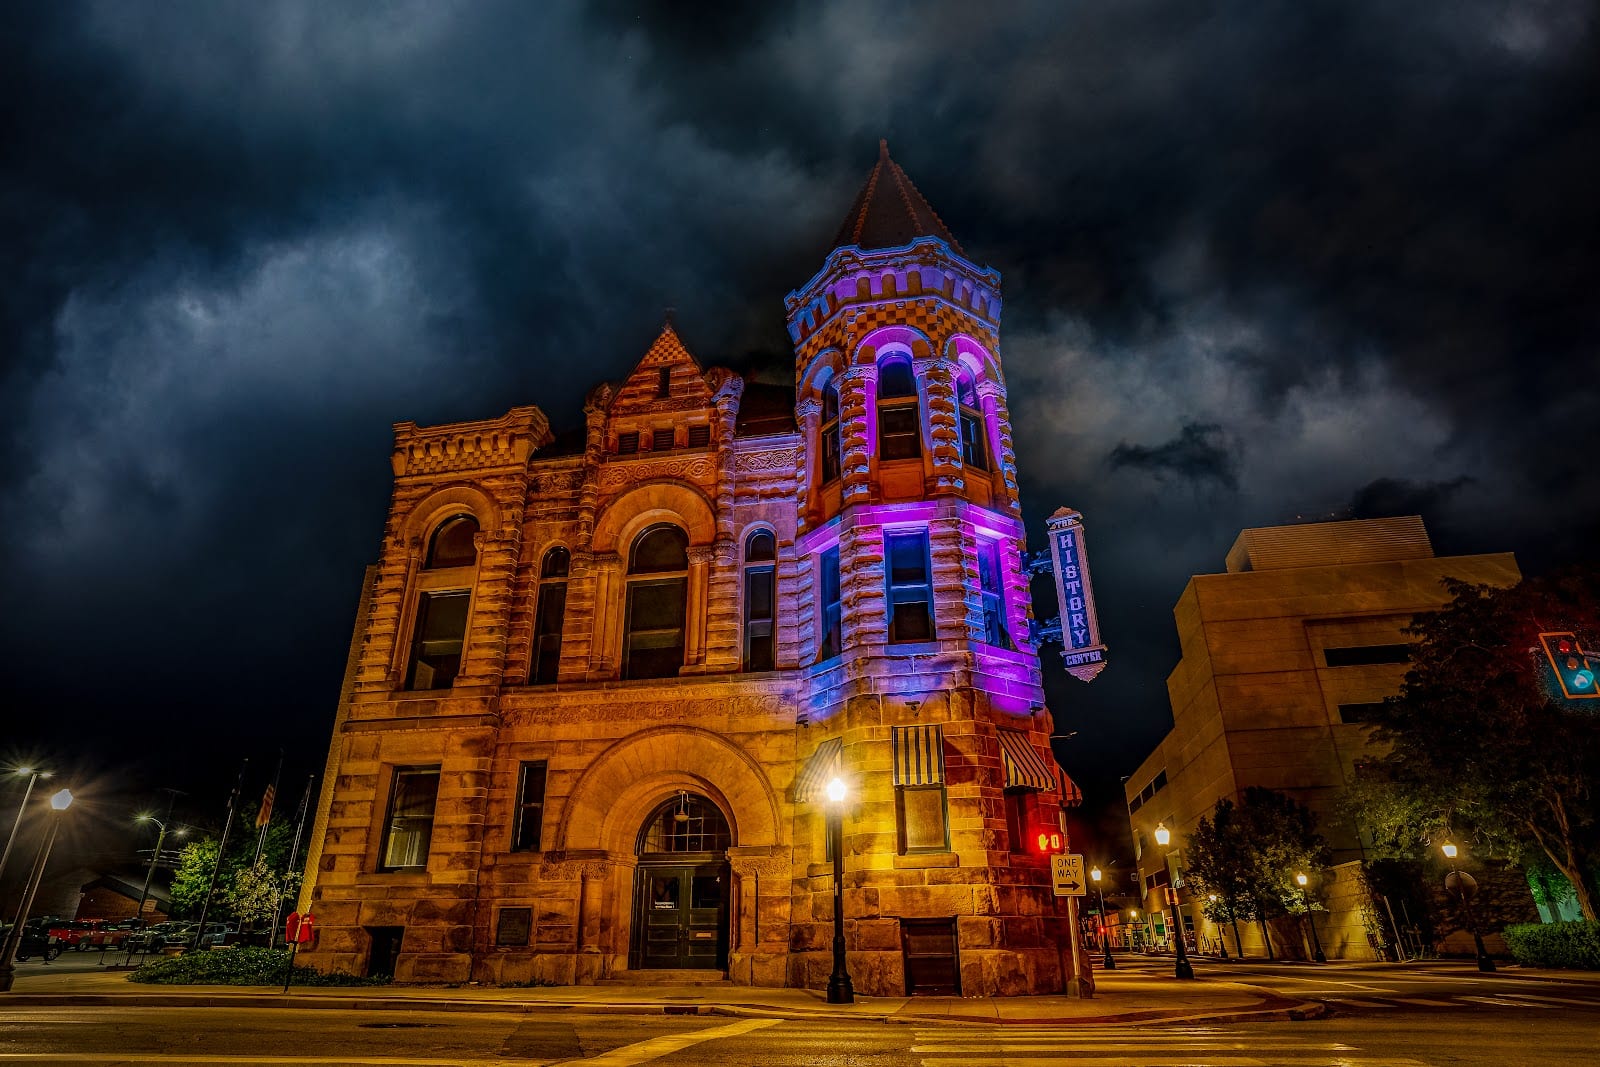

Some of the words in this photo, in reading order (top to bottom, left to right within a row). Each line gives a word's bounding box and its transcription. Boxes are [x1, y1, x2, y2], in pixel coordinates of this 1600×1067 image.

[1056, 519, 1073, 529] THE
[1060, 535, 1086, 644] HISTORY
[1066, 651, 1102, 666] CENTER
[1057, 858, 1078, 868] ONE
[1057, 869, 1079, 878] WAY
